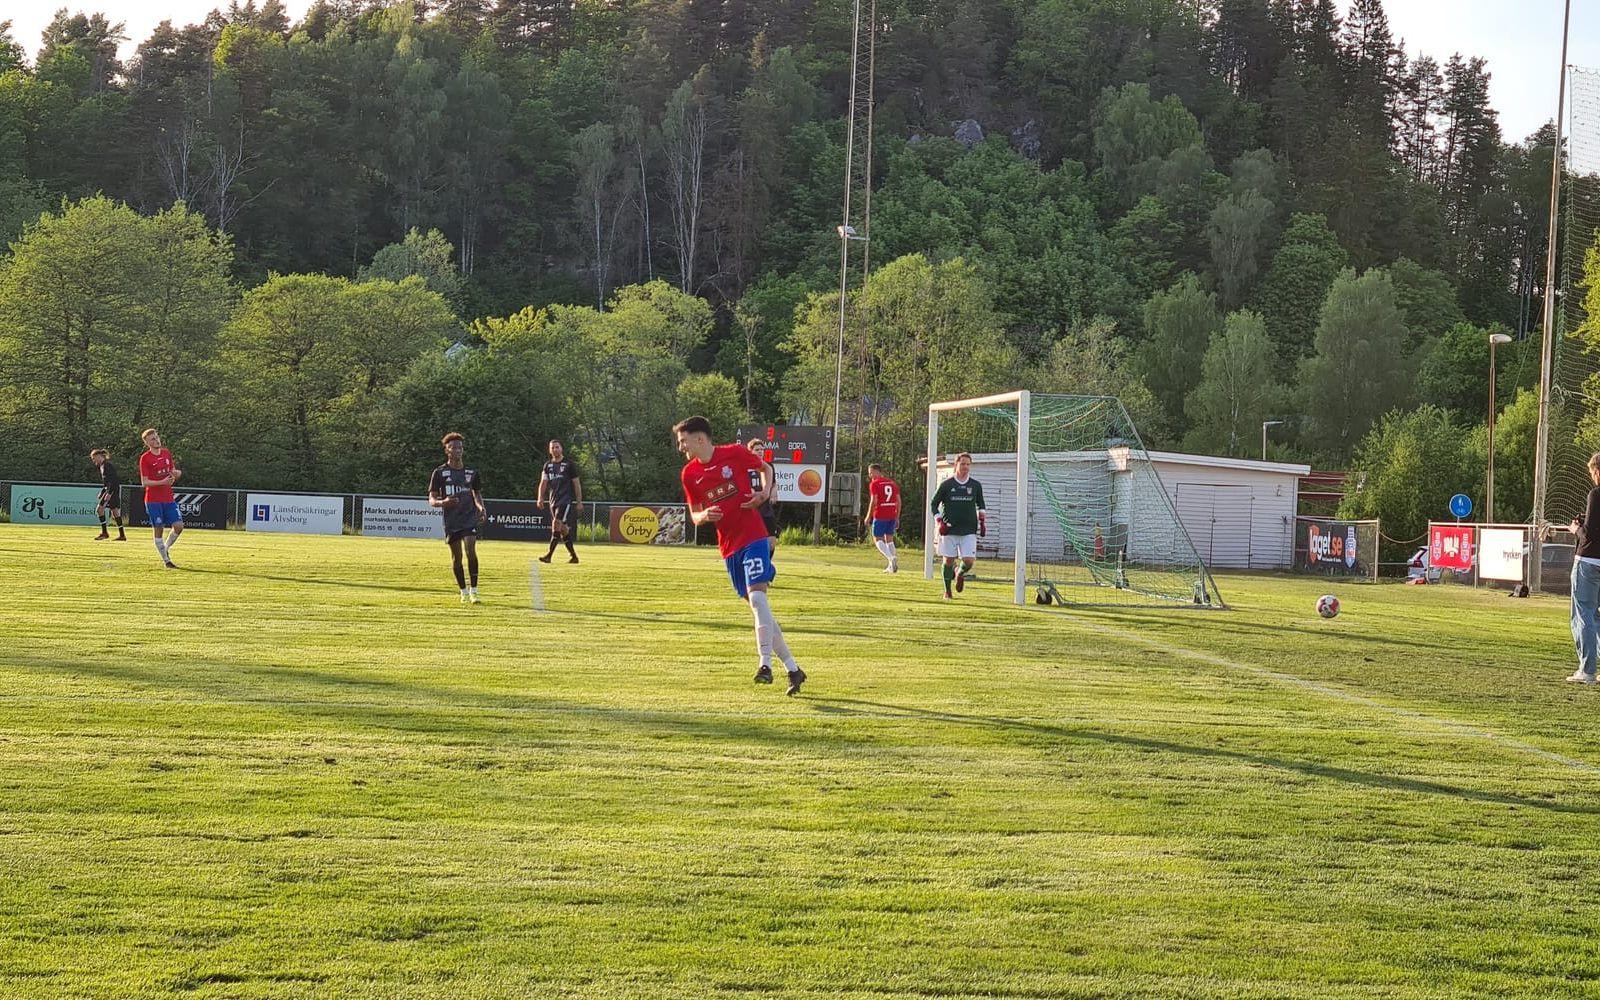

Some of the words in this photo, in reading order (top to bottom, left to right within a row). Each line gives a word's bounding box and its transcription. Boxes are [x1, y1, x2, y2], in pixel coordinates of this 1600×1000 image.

[788, 441, 807, 450] BORTA
[775, 471, 795, 480] nken
[706, 483, 736, 499] BRA
[884, 485, 893, 502] 9
[54, 506, 76, 515] tidlös
[79, 506, 97, 515] desi
[179, 503, 200, 512] SEN
[272, 504, 336, 517] Länsförsäkringar
[364, 507, 387, 515] Marks
[272, 513, 308, 525] Älvsborg
[496, 515, 543, 524] MARGRET
[623, 514, 655, 523] Pizzeria
[626, 522, 653, 538] Örby
[1309, 528, 1343, 561] laget.se
[747, 557, 764, 575] 23
